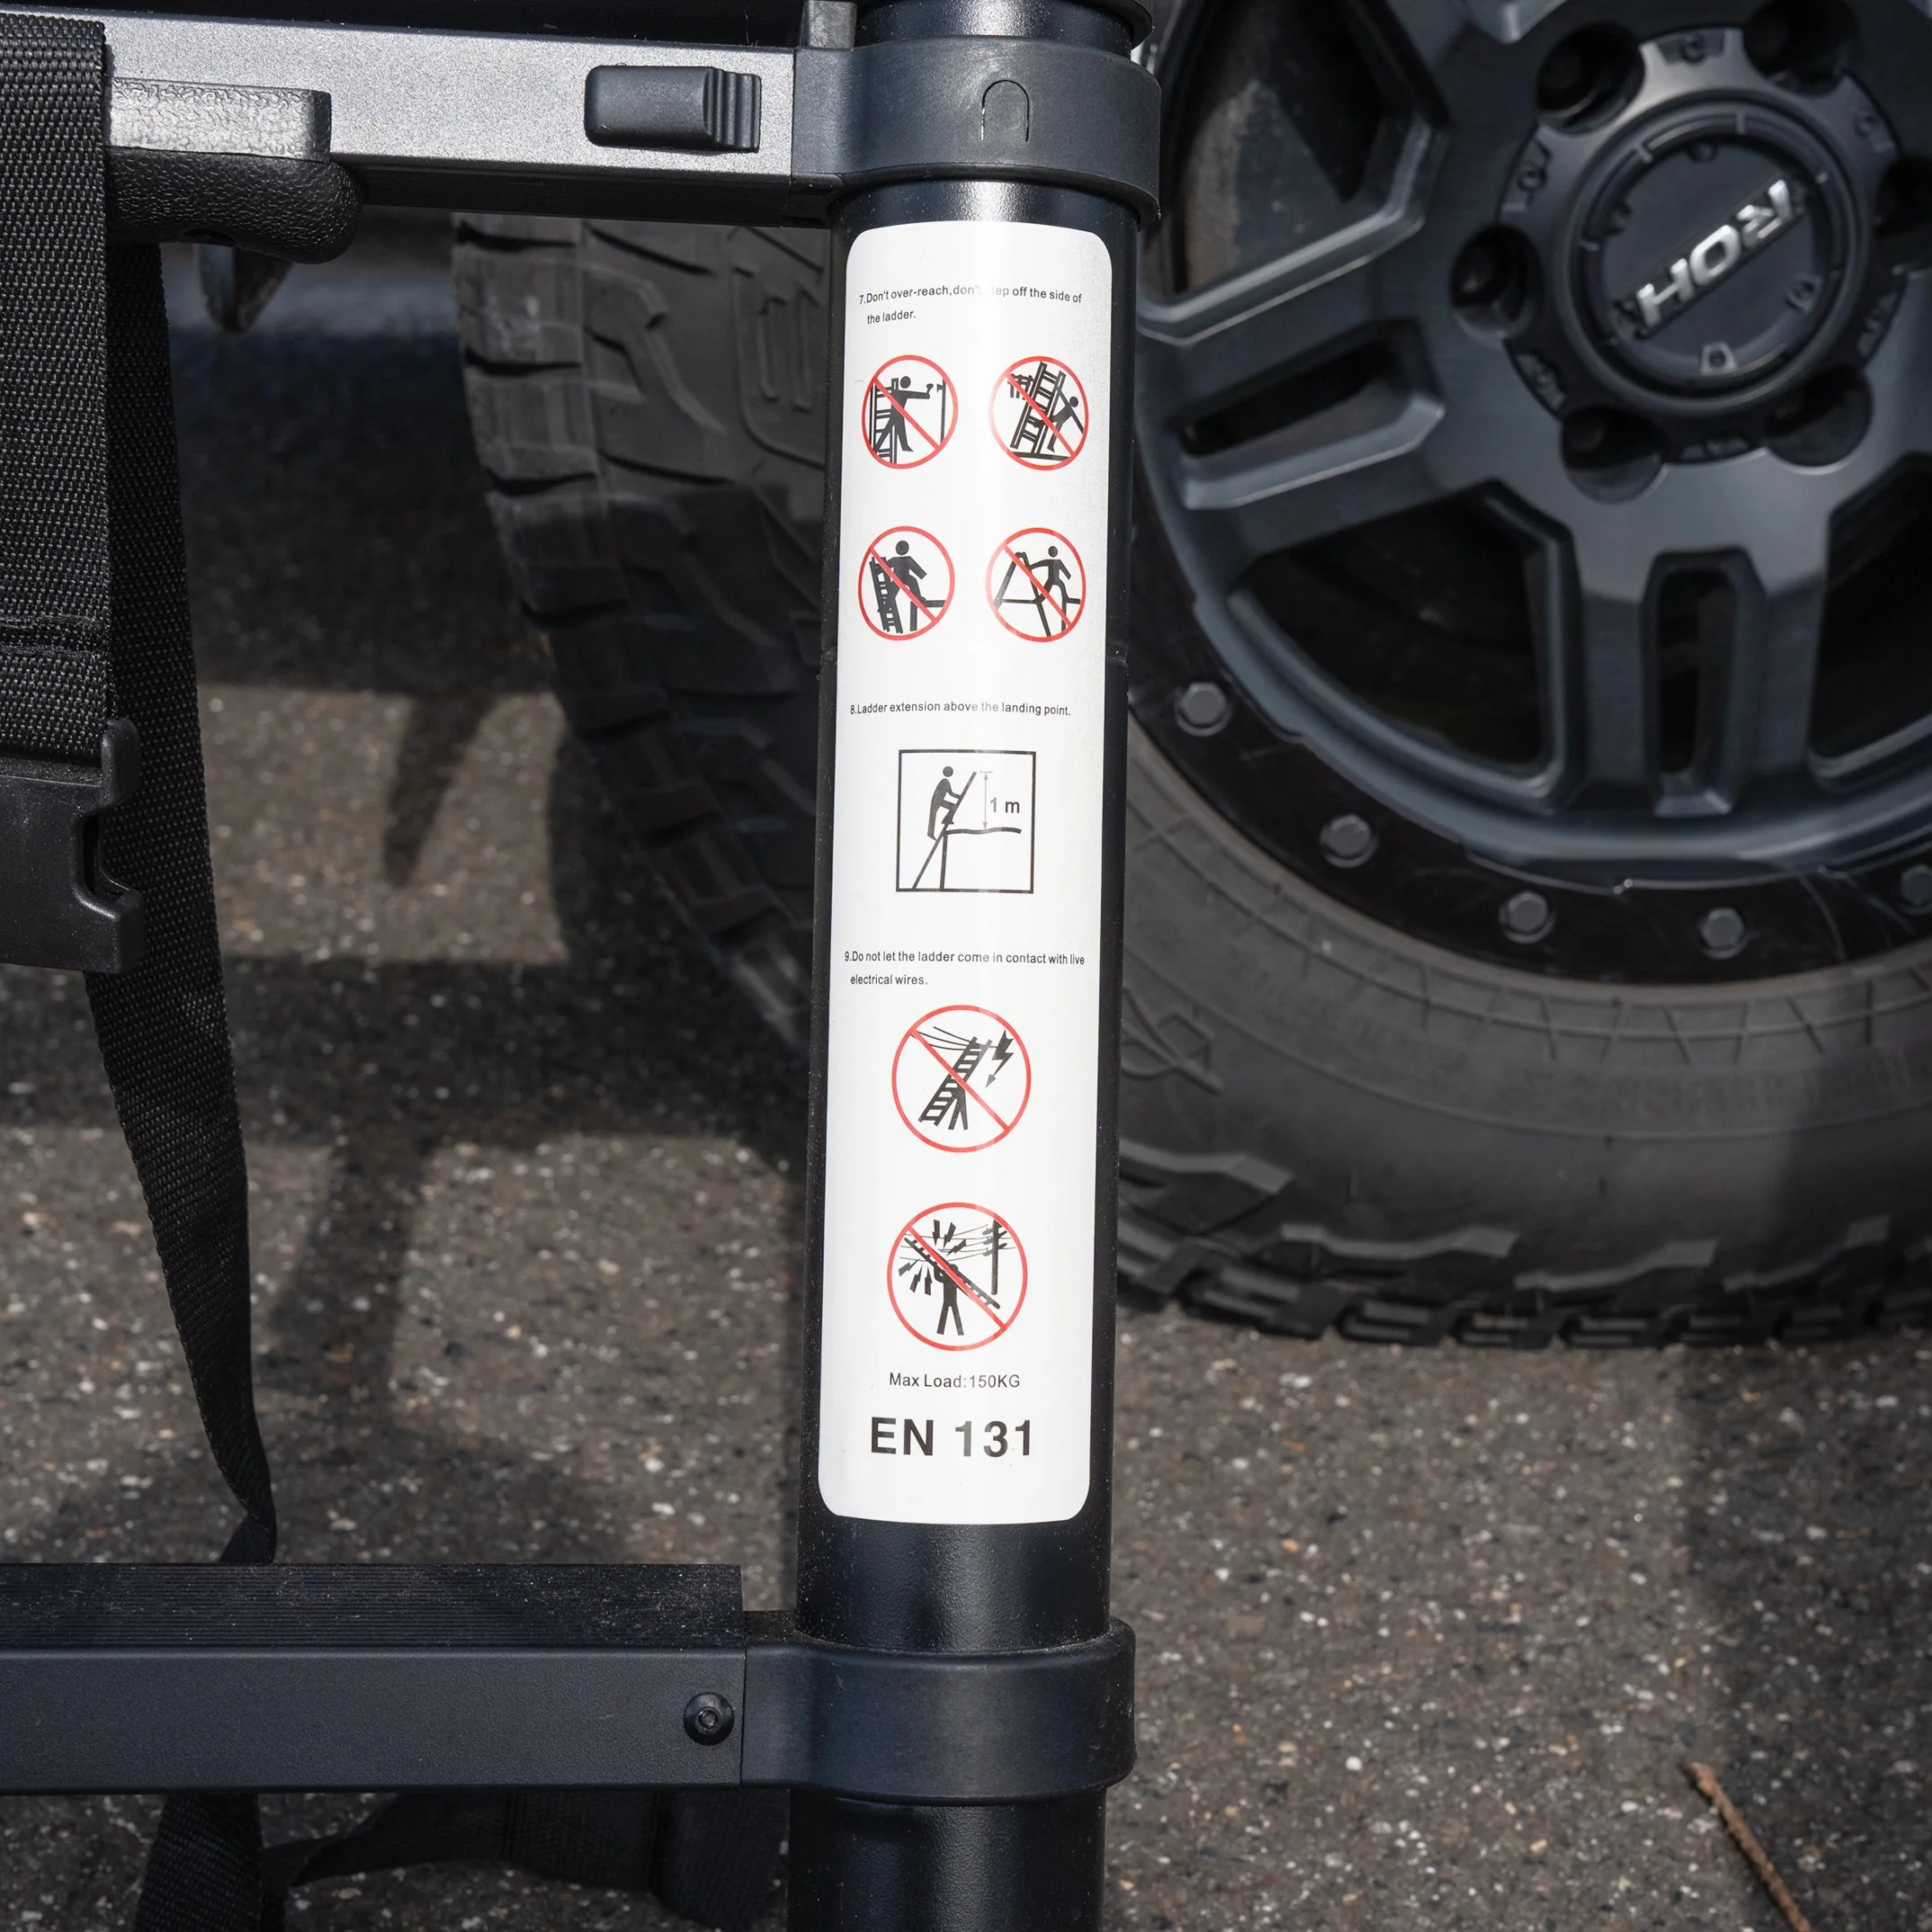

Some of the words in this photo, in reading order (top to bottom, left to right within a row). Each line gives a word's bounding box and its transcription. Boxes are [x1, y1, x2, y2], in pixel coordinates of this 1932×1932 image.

[859, 290, 890, 305] 7.Don't
[986, 285, 1009, 298] tep
[1012, 286, 1027, 297] off
[1029, 288, 1047, 300] the
[1049, 290, 1070, 301] side
[1072, 293, 1083, 304] of
[867, 314, 881, 324] the
[882, 309, 917, 322] ladder.
[850, 702, 888, 715] 8.Ladder
[890, 702, 941, 712] extension
[944, 701, 978, 712] above
[981, 702, 998, 711] the
[1001, 702, 1042, 716] landing
[1044, 705, 1071, 716] point.
[989, 797, 997, 813] 1
[1005, 801, 1020, 813] m
[845, 951, 863, 963] 9.Do
[866, 951, 881, 962] not
[882, 951, 896, 962] let
[898, 951, 915, 962] the
[917, 951, 955, 962] ladder
[958, 953, 989, 962] come
[993, 952, 1003, 962] in
[1006, 951, 1046, 963] contact
[1047, 953, 1068, 964] with
[1070, 954, 1085, 965] live
[850, 973, 892, 985] electrical
[895, 974, 927, 986] wires.
[889, 1373, 919, 1387] Max
[871, 1416, 934, 1456] EN
[954, 1419, 1031, 1457] 131
